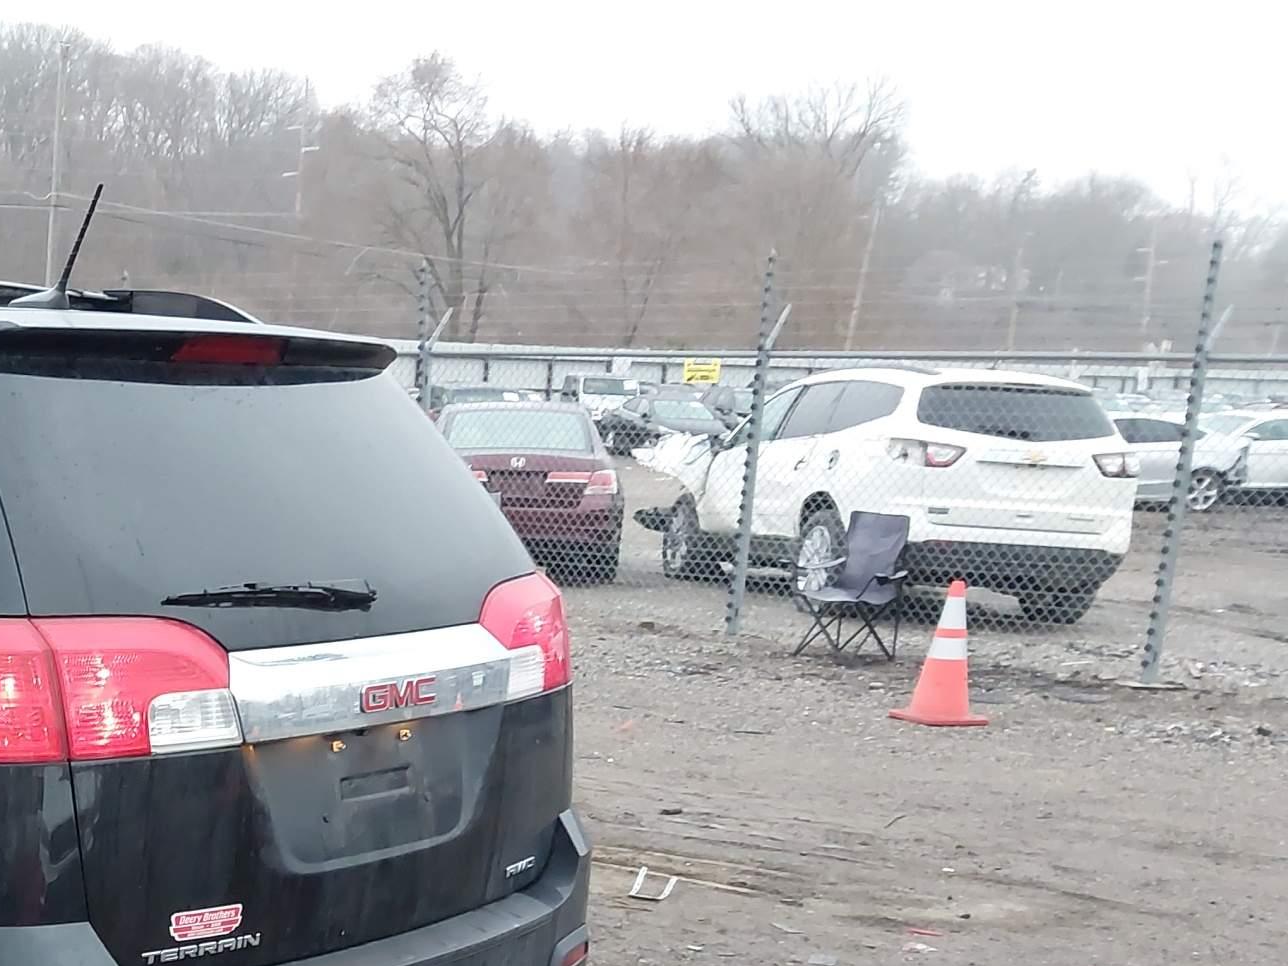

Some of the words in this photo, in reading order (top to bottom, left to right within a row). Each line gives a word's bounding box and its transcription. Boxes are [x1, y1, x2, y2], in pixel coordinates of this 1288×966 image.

[360, 674, 437, 713] GMC
[202, 909, 236, 922] Brothers
[141, 932, 261, 966] TERRAIN
